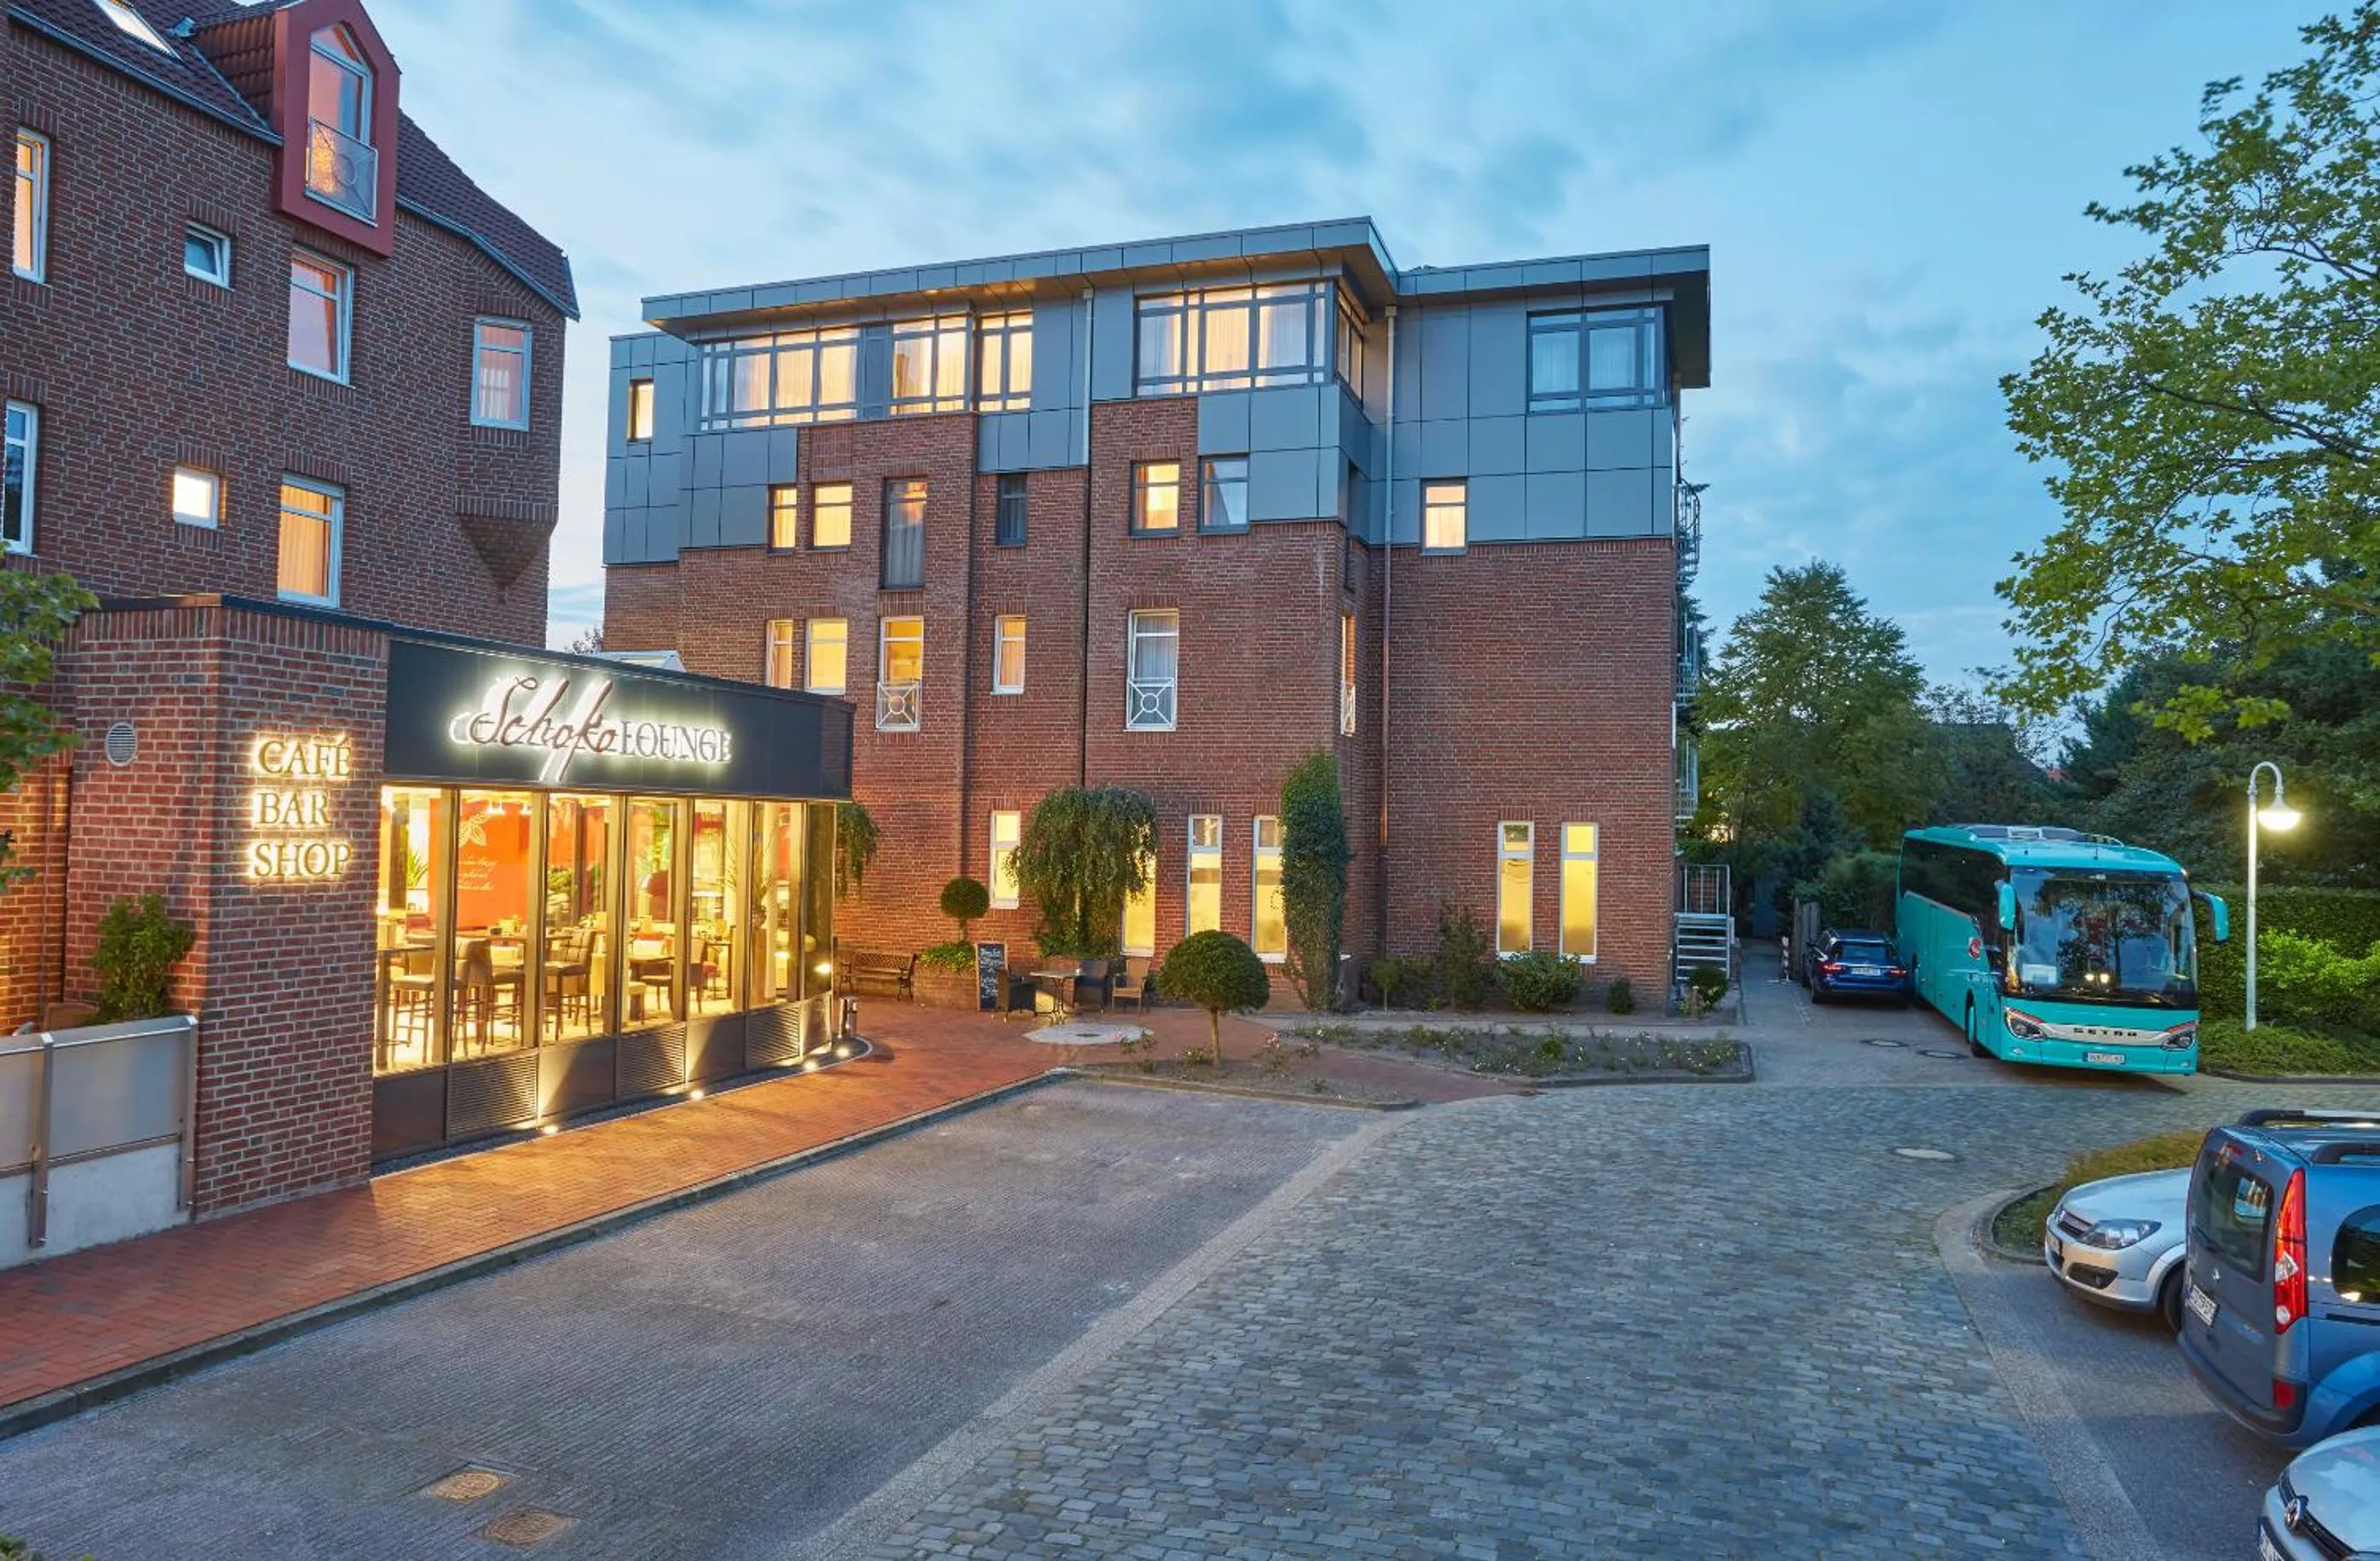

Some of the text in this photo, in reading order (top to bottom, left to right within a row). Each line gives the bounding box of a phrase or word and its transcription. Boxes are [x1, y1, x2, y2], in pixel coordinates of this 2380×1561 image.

[469, 676, 733, 782] Schoko LOUNGE
[258, 735, 351, 777] CAFÉ
[257, 790, 333, 825] BAR
[255, 843, 354, 877] SHOP
